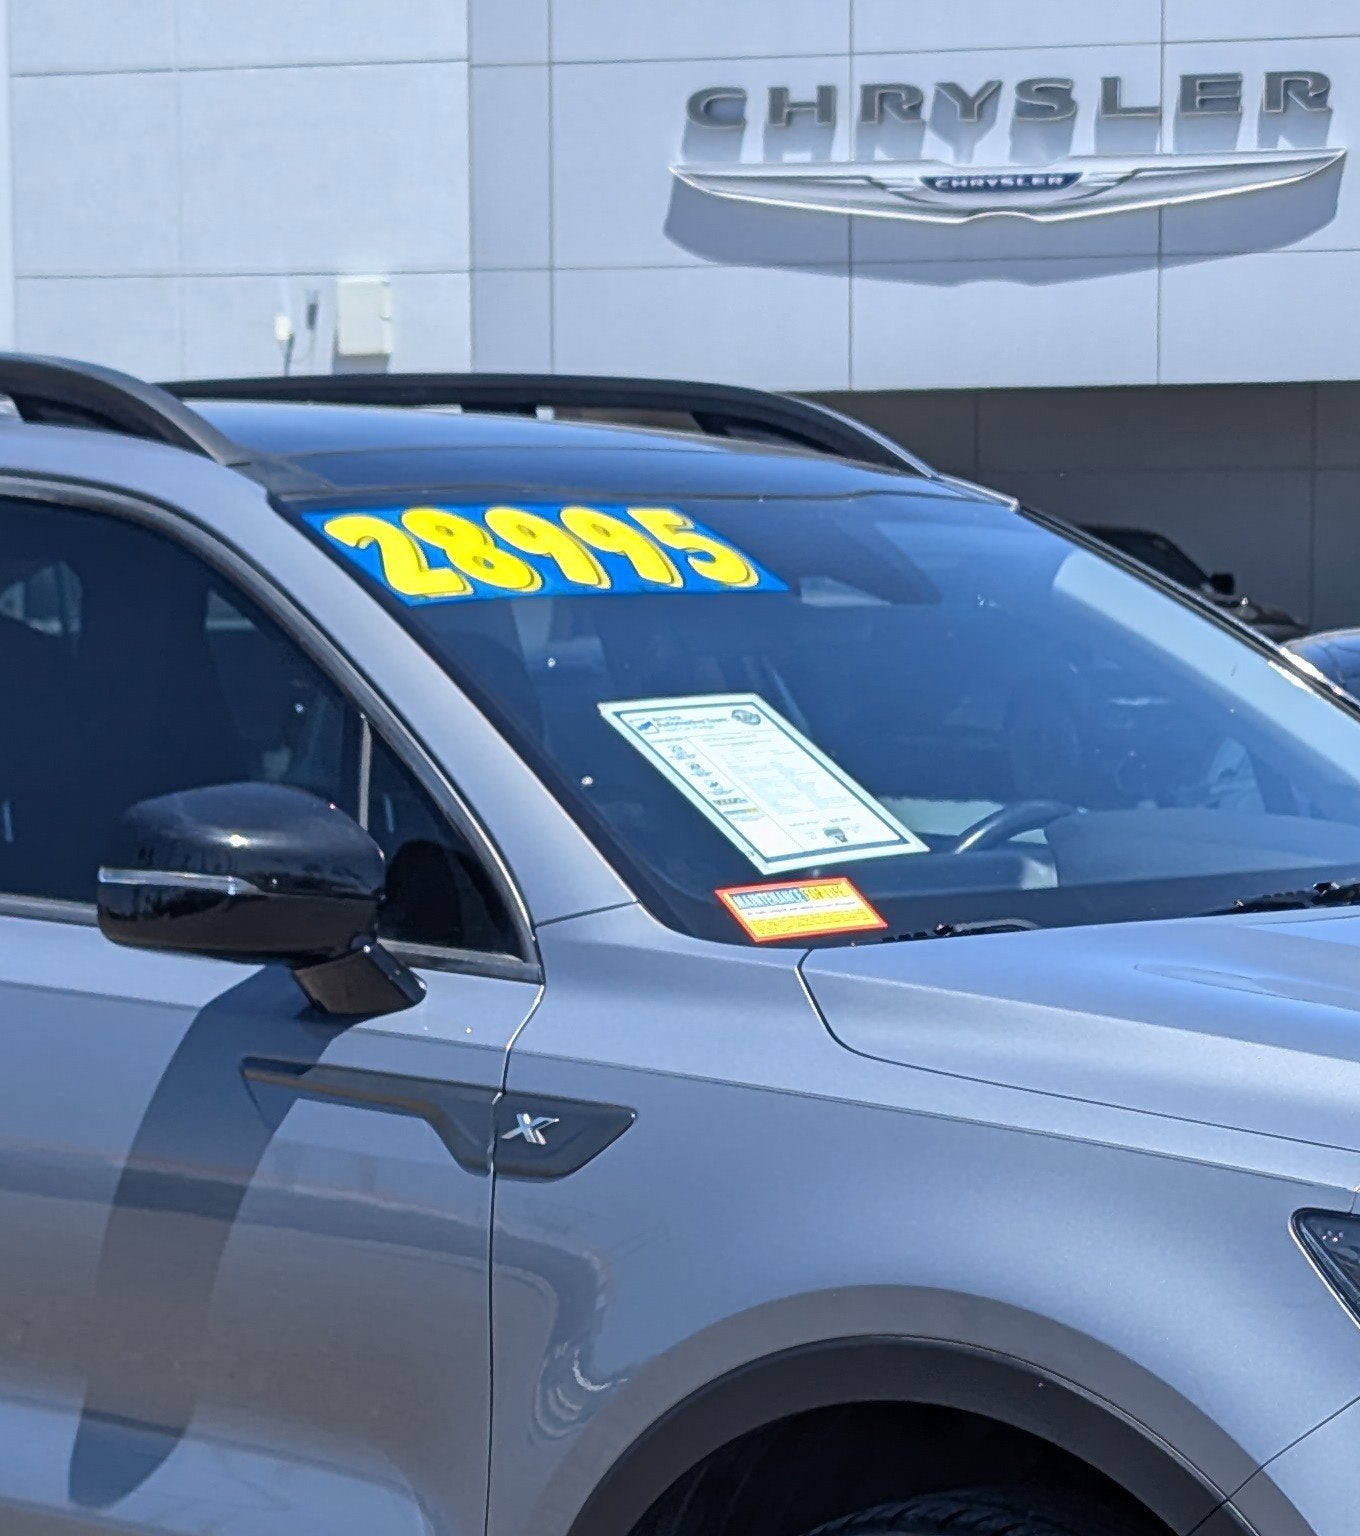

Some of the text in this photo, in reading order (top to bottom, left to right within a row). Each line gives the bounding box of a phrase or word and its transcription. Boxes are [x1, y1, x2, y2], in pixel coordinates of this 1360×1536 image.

[685, 69, 1333, 129] CHRYSLER
[934, 175, 1065, 189] CHRYSLER
[323, 506, 760, 597] 28995
